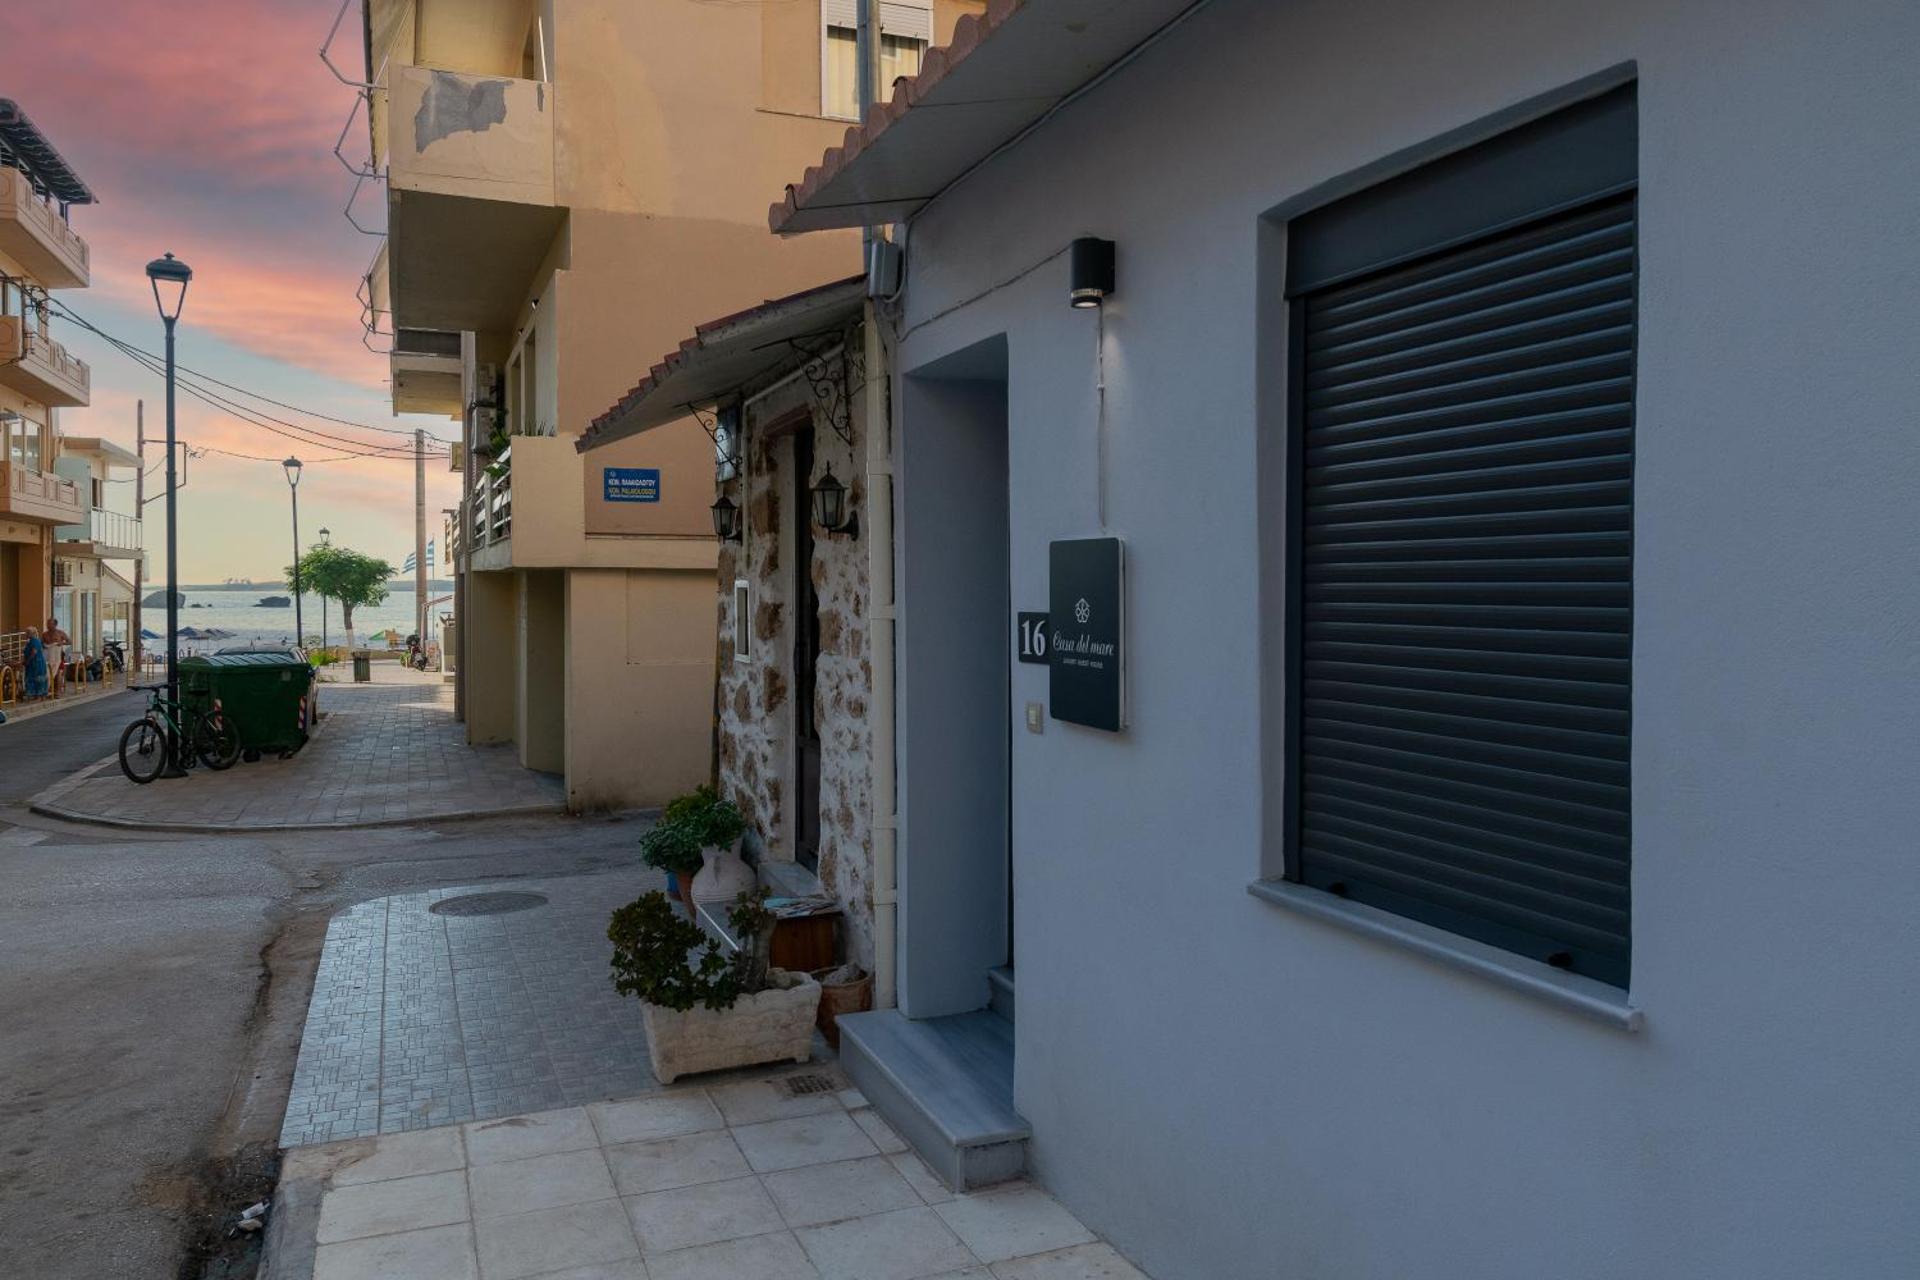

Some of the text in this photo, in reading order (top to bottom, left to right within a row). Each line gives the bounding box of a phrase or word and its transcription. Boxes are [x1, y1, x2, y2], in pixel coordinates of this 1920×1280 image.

[1021, 620, 1046, 656] 16
[1053, 630, 1115, 656] Casa del mare
